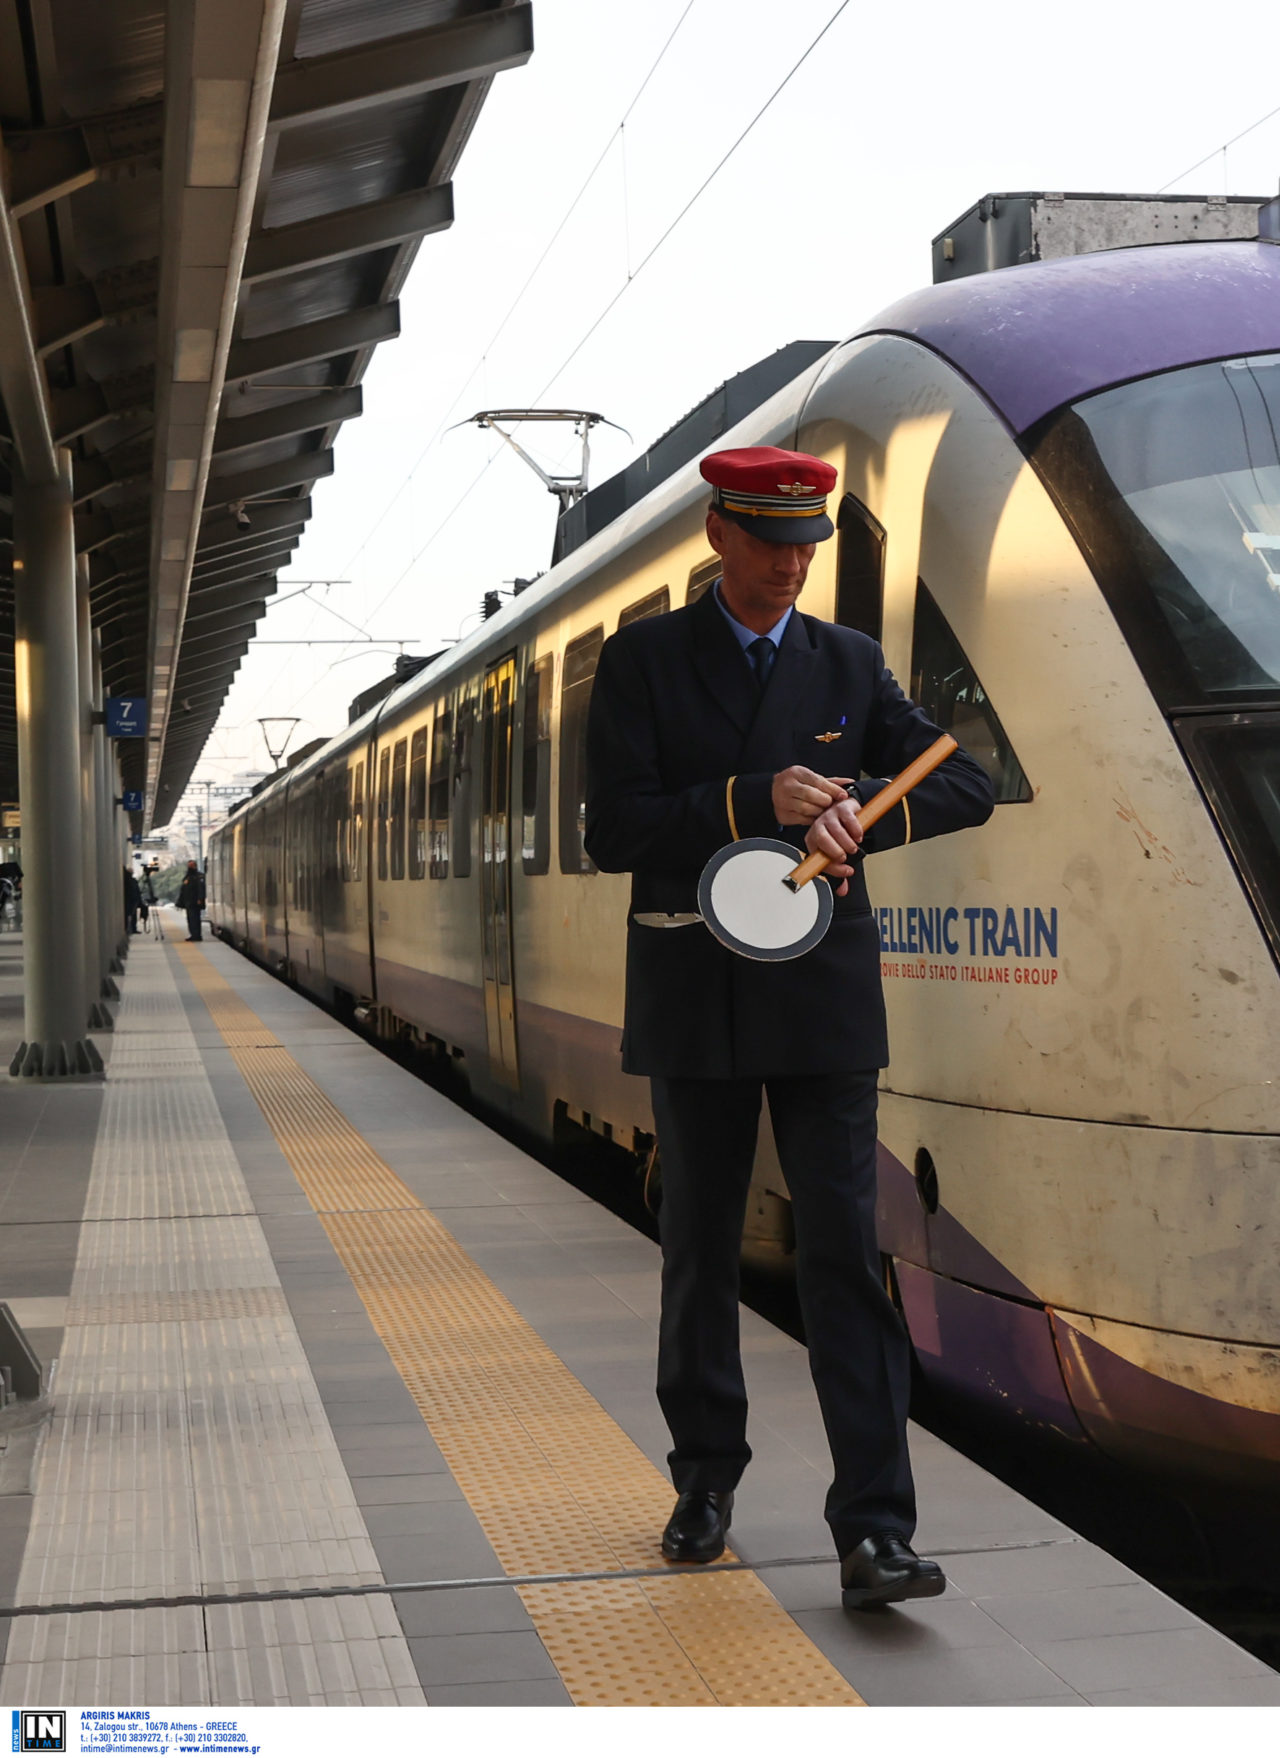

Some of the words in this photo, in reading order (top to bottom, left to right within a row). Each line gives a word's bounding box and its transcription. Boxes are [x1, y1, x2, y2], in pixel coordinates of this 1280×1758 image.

[120, 702, 133, 718] 7
[964, 907, 1058, 958] TRAIN
[902, 963, 926, 979] DELLO
[929, 964, 957, 981] STATO
[961, 965, 1010, 984] ITALIANE
[1014, 967, 1059, 986] GROUP
